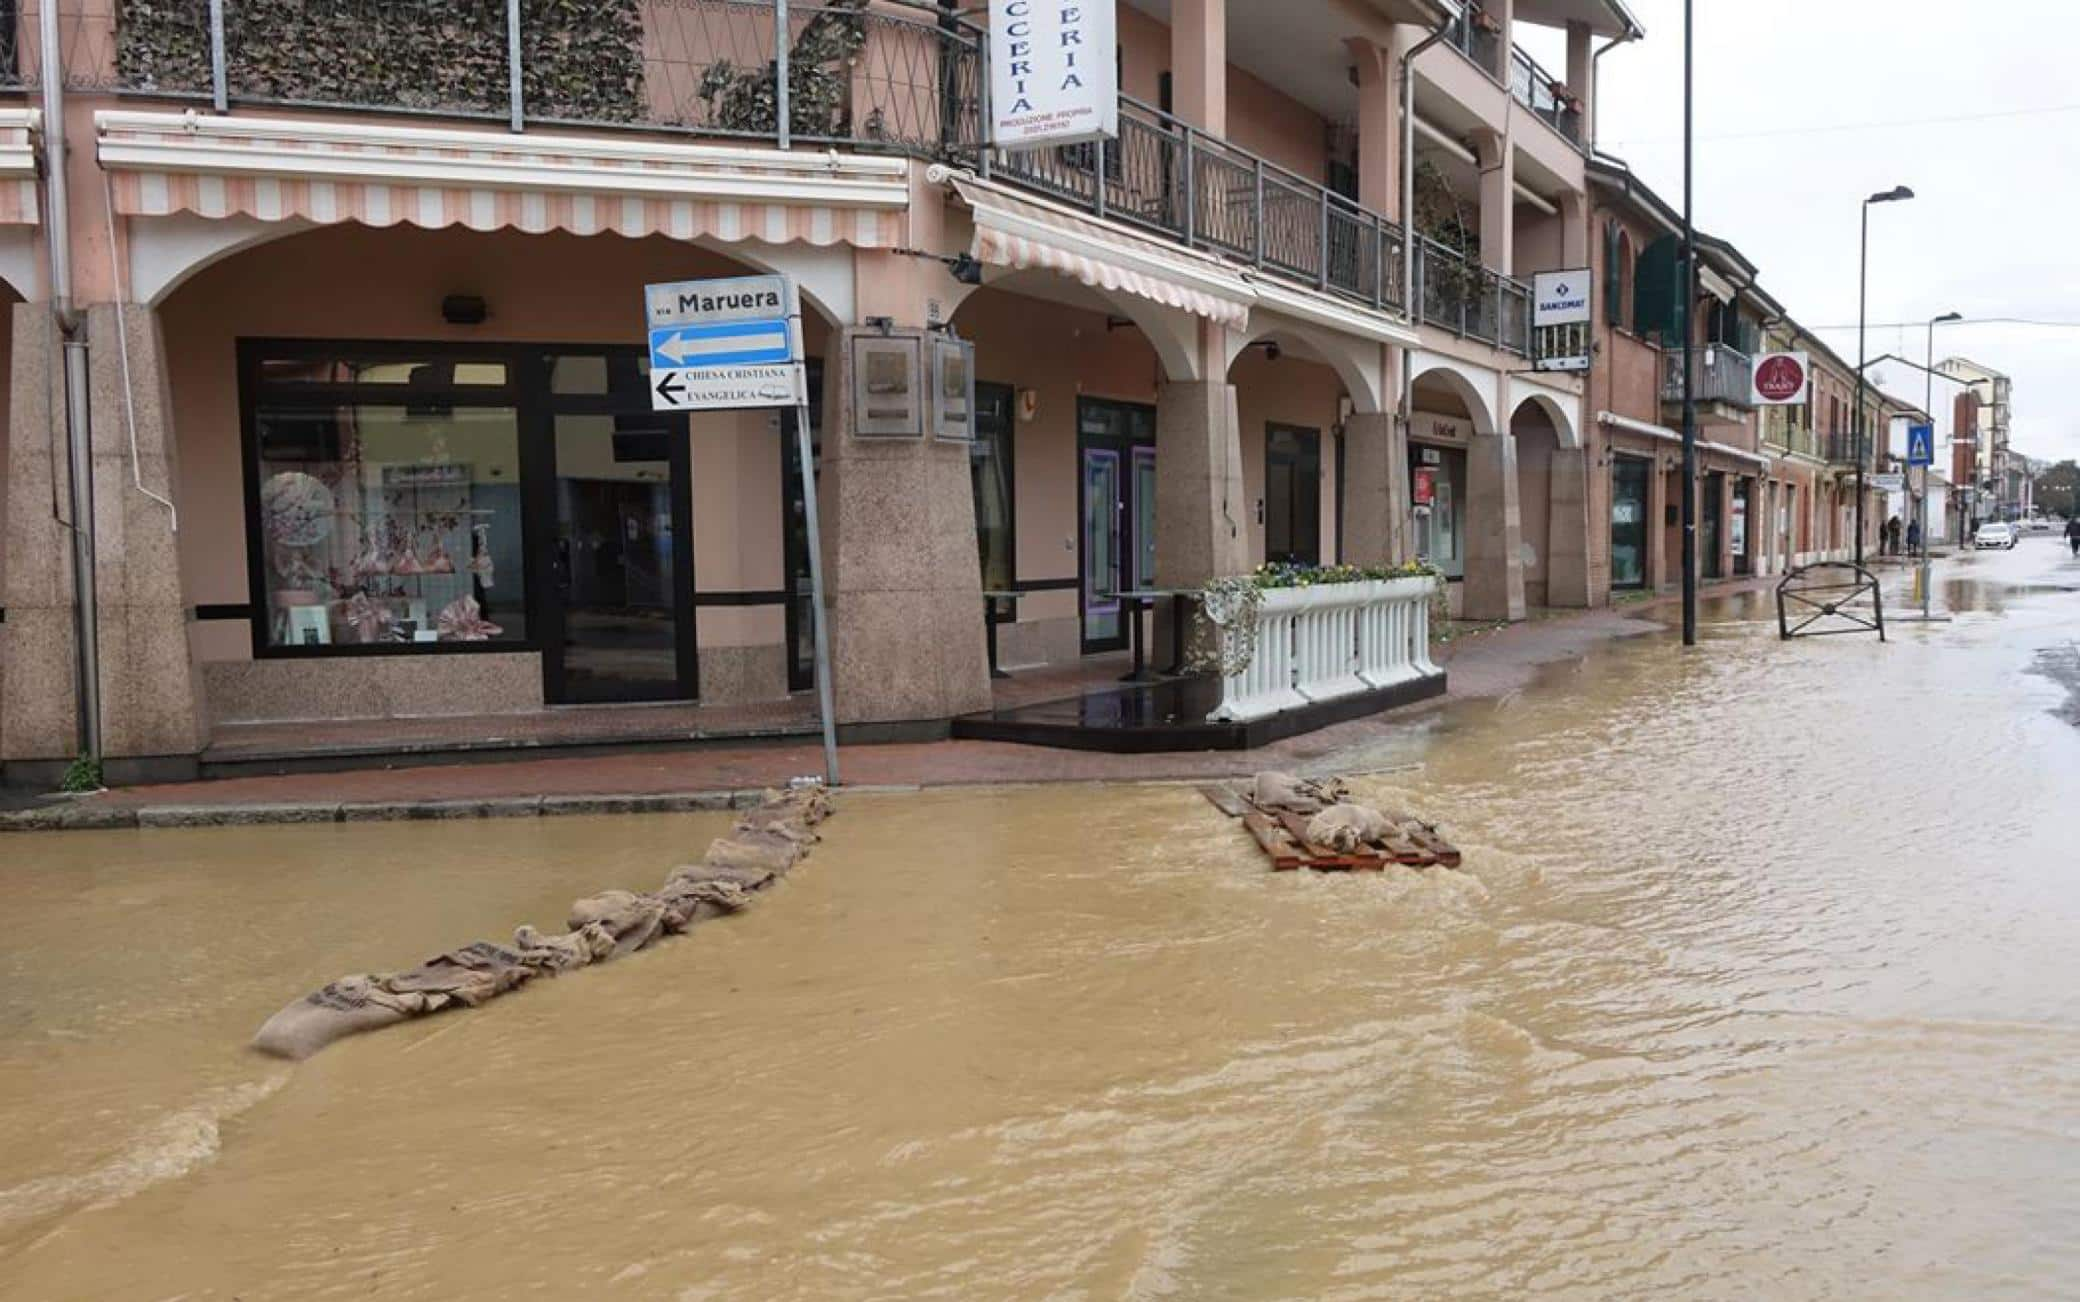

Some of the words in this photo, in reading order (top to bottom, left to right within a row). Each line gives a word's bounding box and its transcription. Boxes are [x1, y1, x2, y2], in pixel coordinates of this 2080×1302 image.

[1060, 0, 1083, 91] ERIA
[679, 291, 780, 313] Maruera
[1539, 298, 1585, 312] BANCOMAT
[685, 370, 727, 381] CHIESA
[727, 368, 786, 380] CRISTIANA
[687, 390, 757, 402] EVANGELICA
